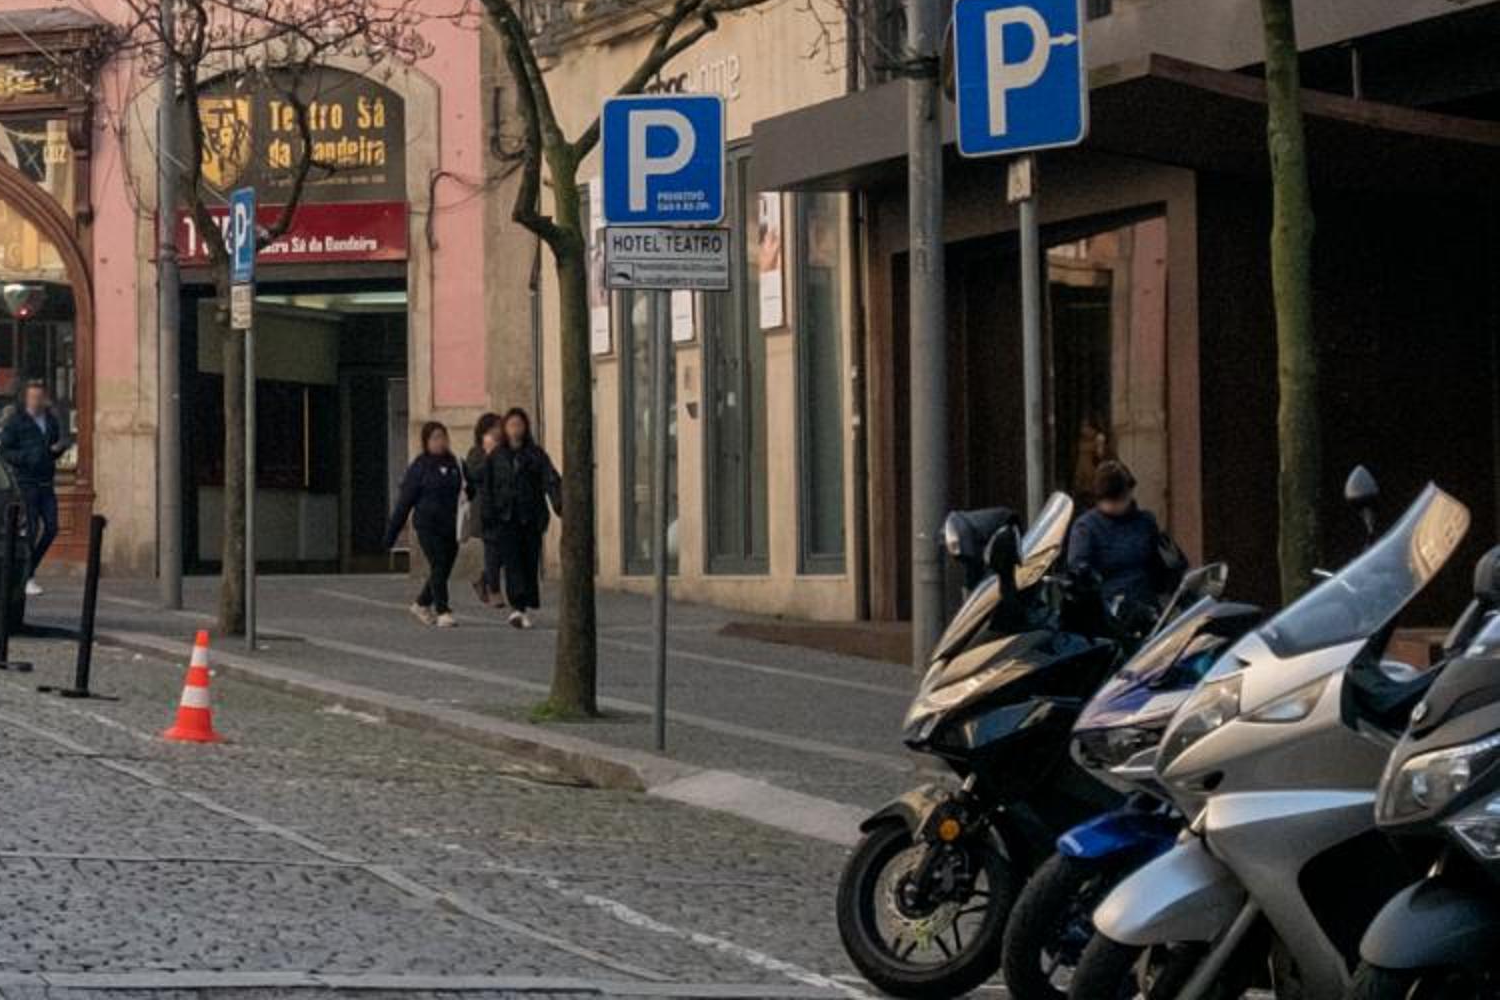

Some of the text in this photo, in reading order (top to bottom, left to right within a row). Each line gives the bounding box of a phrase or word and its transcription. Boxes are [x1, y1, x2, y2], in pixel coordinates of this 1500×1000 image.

[984, 6, 1051, 136] P
[269, 95, 385, 131] Tetro Sá
[268, 135, 385, 168] da andeira
[628, 109, 696, 212] P
[235, 202, 247, 271] P
[613, 234, 722, 253] HOTEL TEATRO
